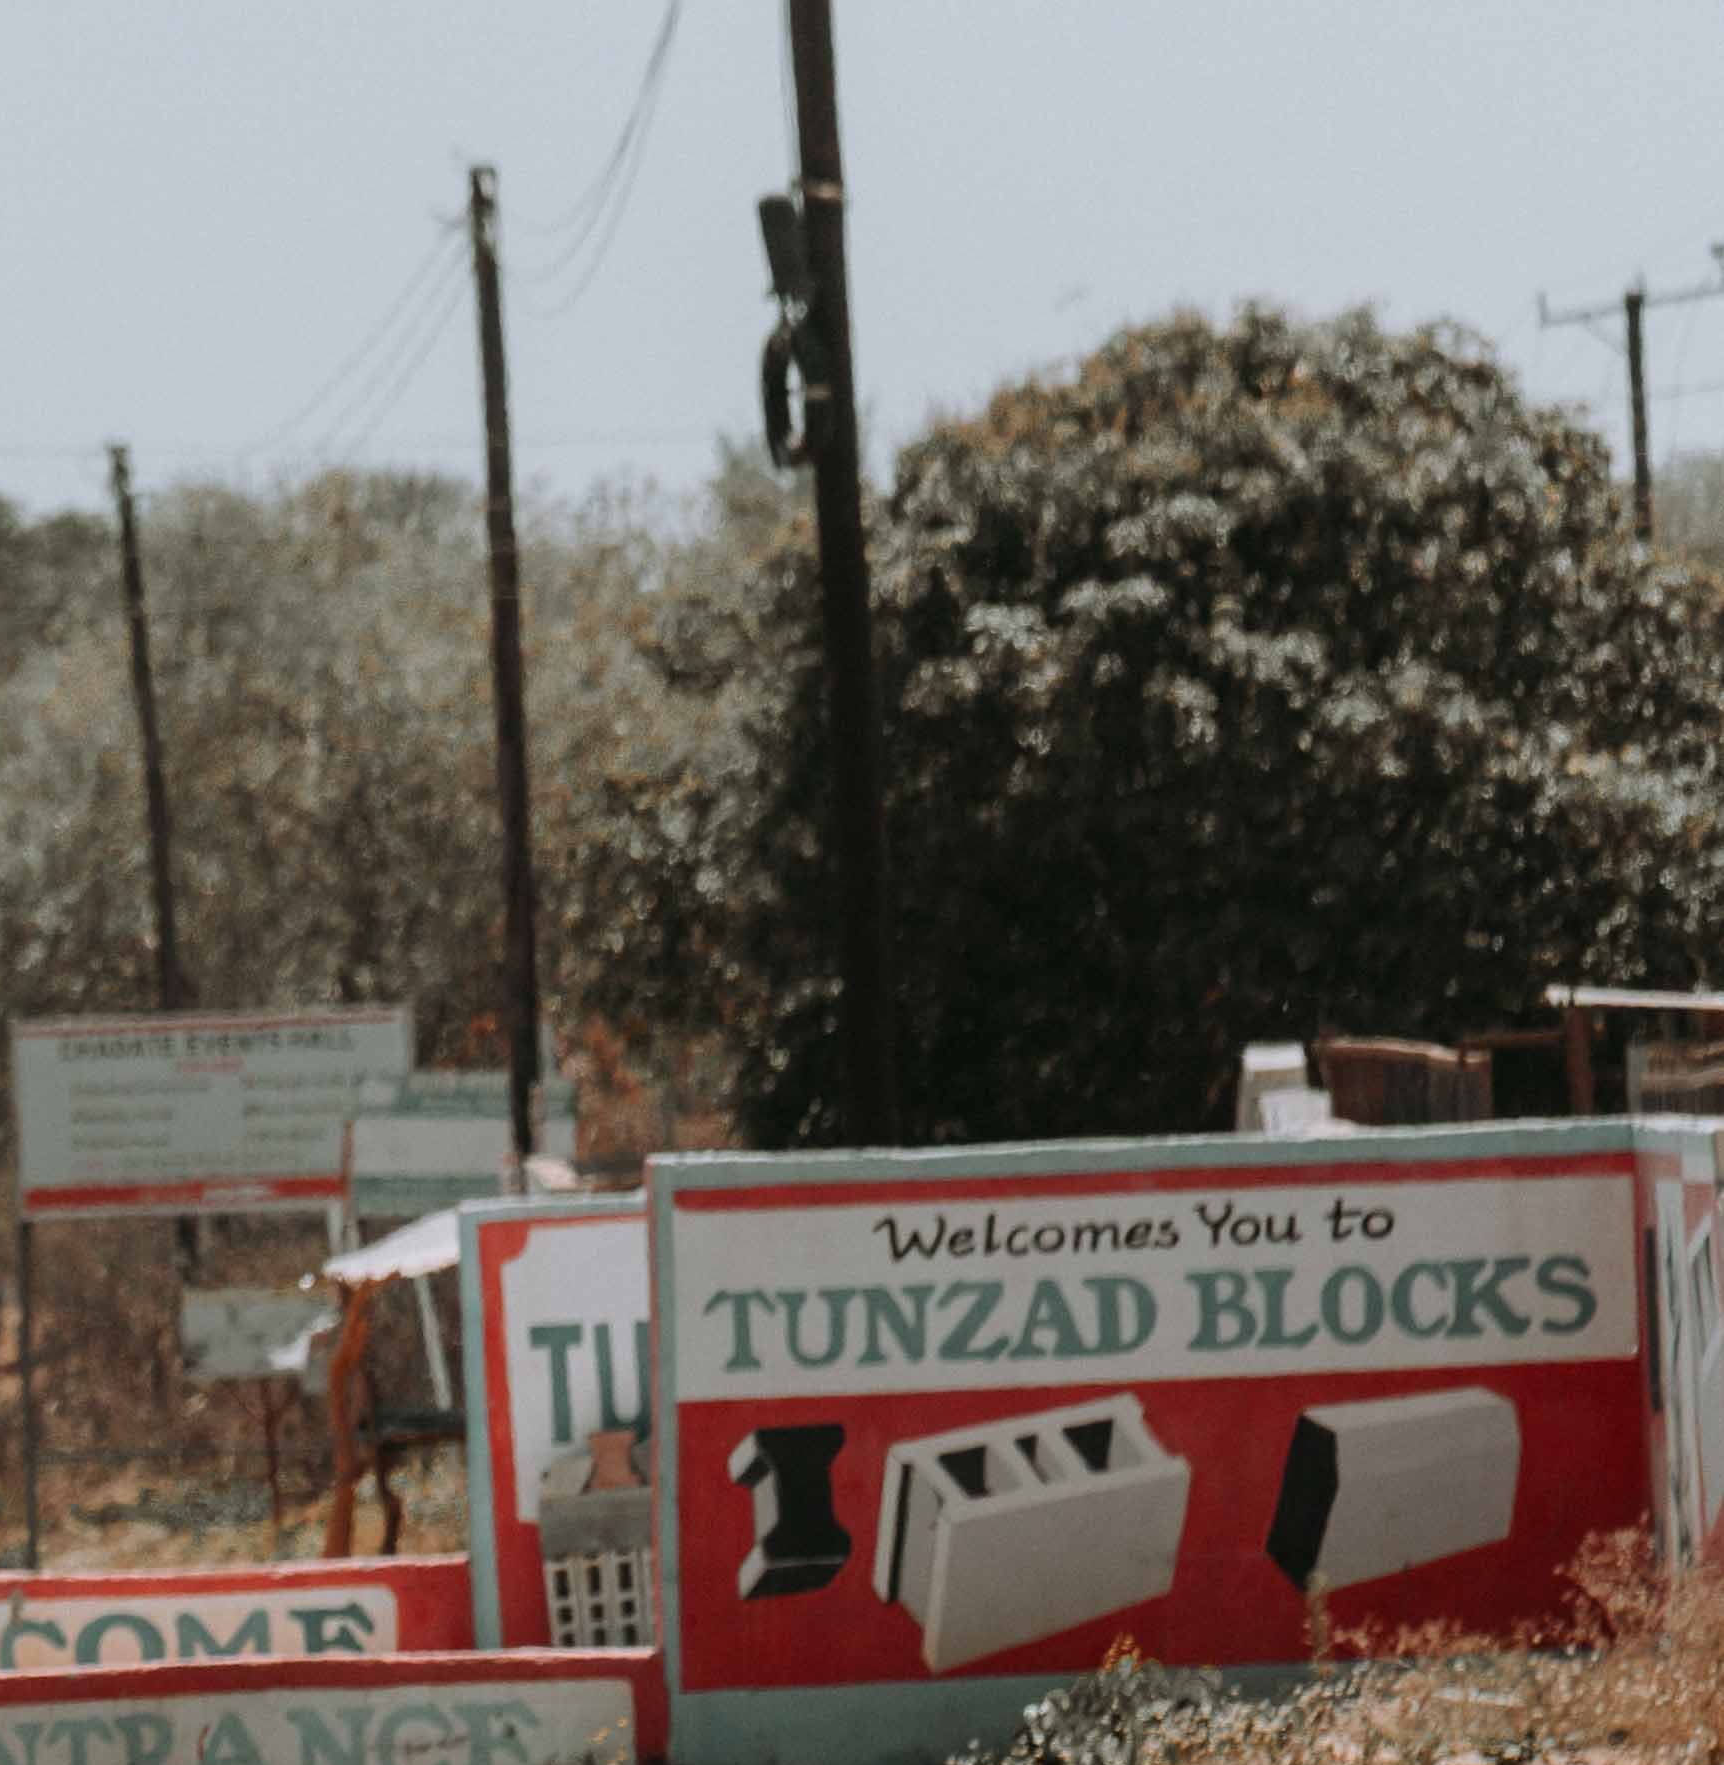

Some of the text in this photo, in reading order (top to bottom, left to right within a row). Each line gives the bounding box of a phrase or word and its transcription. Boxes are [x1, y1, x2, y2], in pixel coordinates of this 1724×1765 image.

[874, 1198, 1396, 1264] Welcomes You to
[703, 1255, 1598, 1372] TUNZAD BLOCKS
